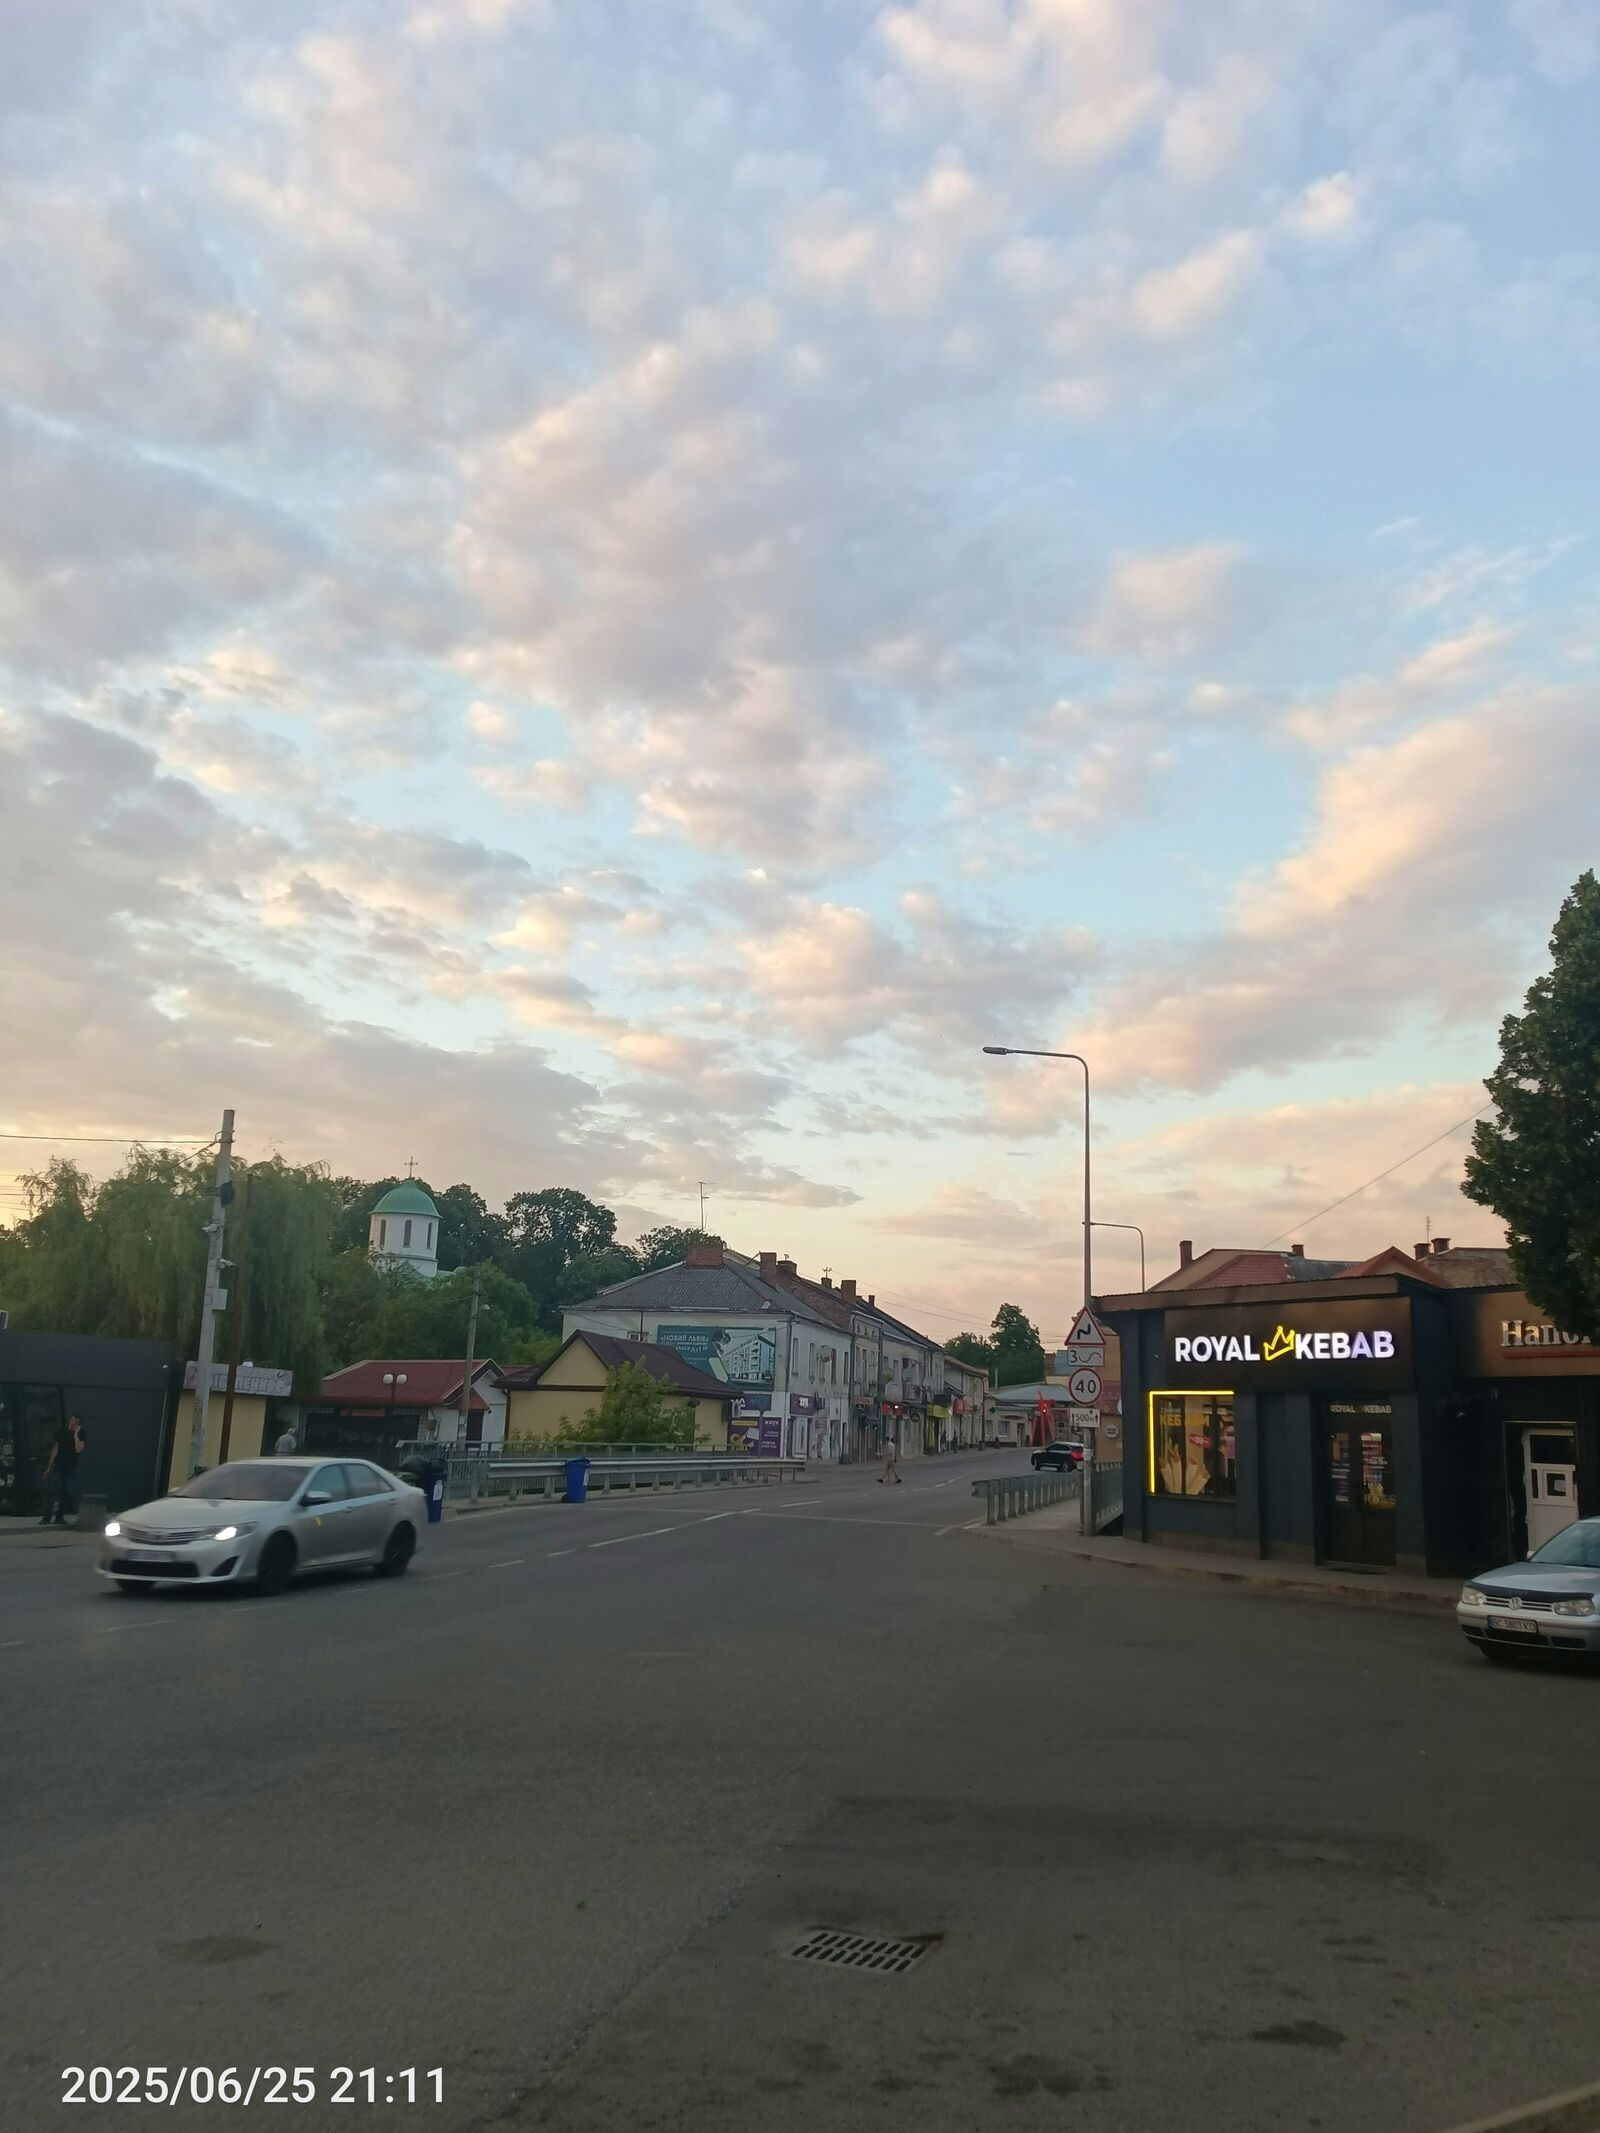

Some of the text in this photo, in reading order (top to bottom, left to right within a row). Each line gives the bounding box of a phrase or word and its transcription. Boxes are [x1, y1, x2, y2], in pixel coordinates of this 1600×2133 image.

[1174, 1330, 1395, 1362] ROYAL KEBAB
[1069, 1349, 1078, 1363] 3
[1075, 1379, 1097, 1394] 40
[1330, 1405, 1392, 1414] ROYAL KEBAB
